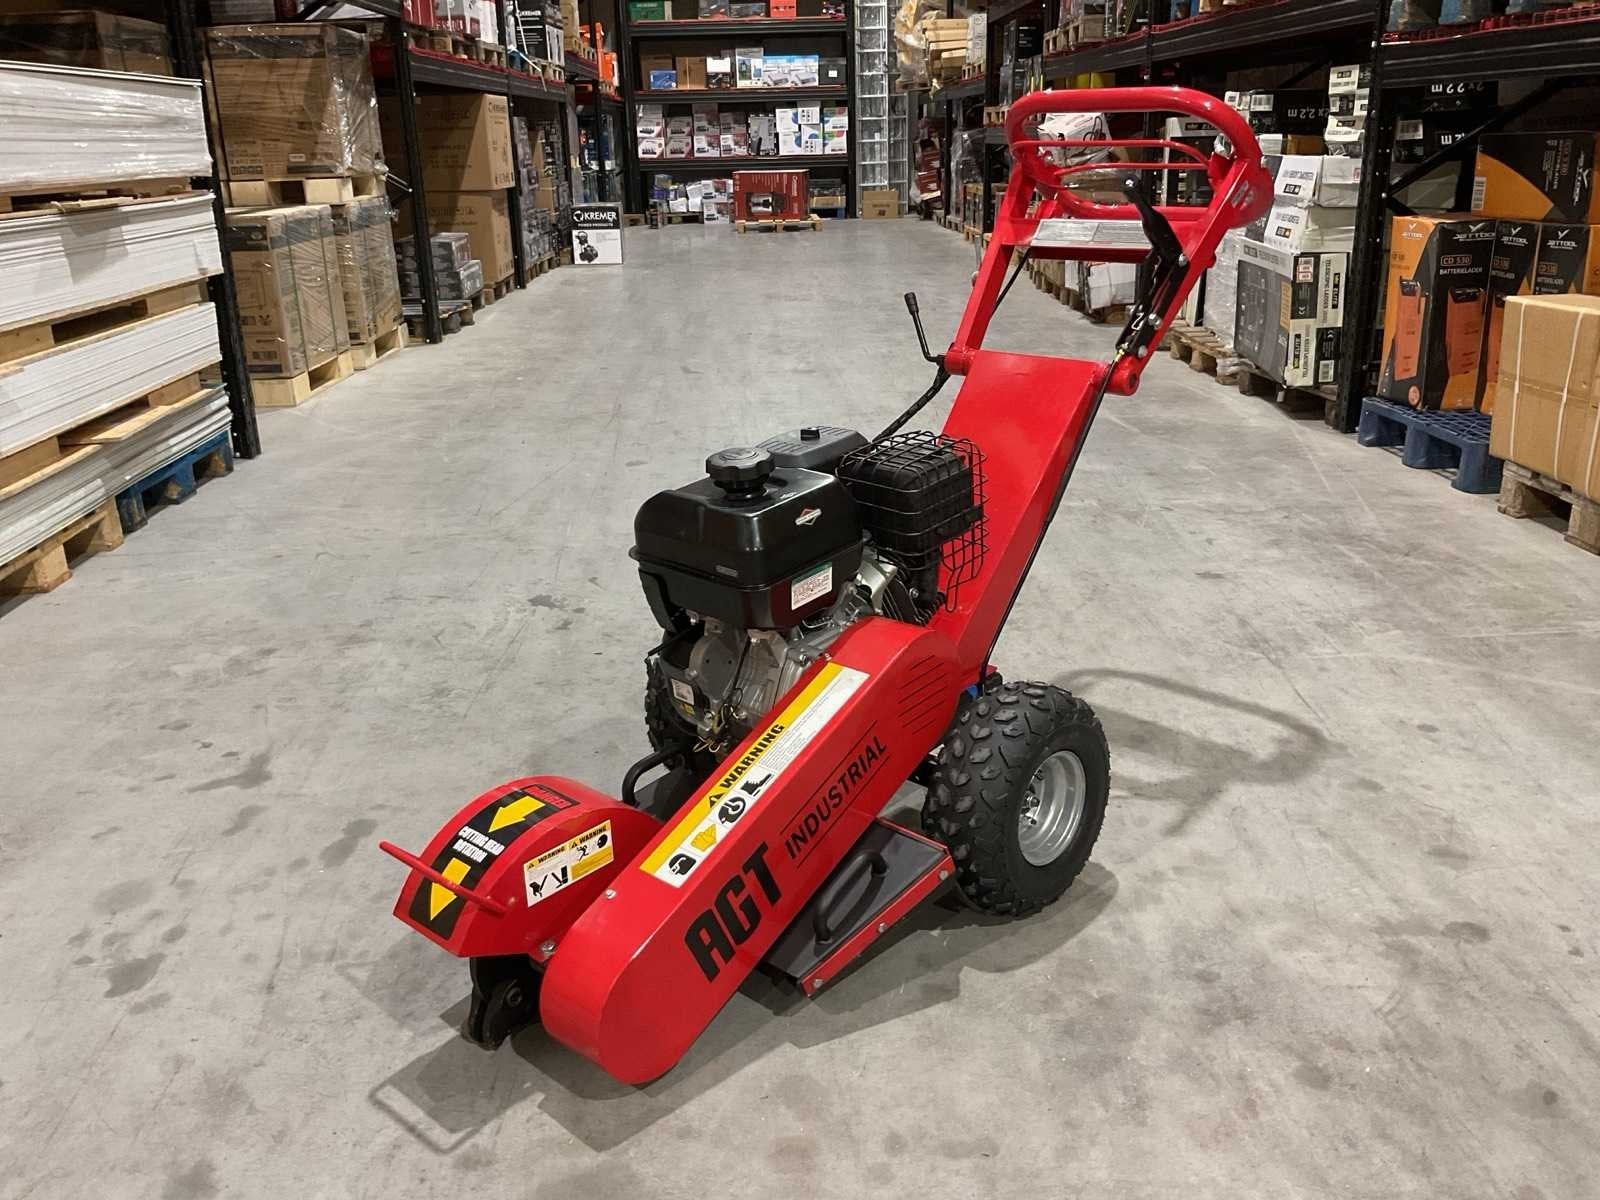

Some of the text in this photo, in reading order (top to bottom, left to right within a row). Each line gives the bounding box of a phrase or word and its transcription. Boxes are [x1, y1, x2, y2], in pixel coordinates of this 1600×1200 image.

[1287, 108, 1298, 118] m
[1300, 107, 1316, 119] 2,2
[584, 212, 617, 221] KREMER
[720, 723, 785, 788] WARNING
[784, 735, 888, 861] INDUSTRIAL
[578, 825, 607, 844] WARNING
[537, 845, 566, 864] WARNING
[684, 841, 783, 984] AGT
